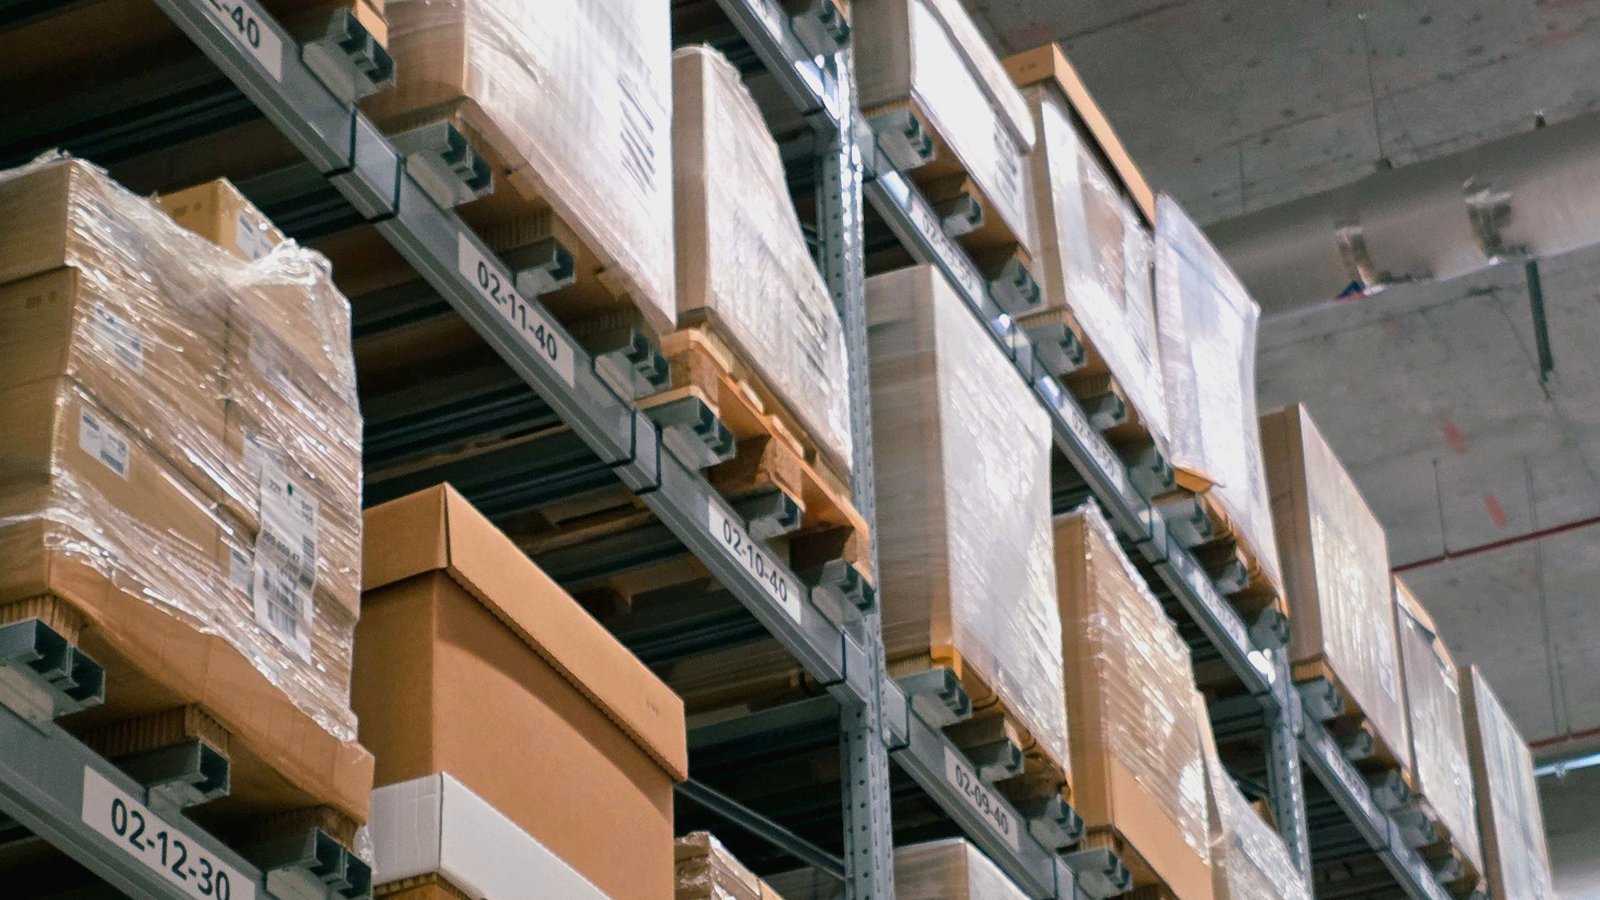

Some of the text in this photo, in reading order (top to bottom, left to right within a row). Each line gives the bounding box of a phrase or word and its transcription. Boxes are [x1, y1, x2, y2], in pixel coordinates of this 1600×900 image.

[208, 0, 260, 48] -40
[477, 260, 557, 361] 02-11-40
[723, 518, 787, 603] 02-10-40
[955, 764, 1009, 835] 02-09-40
[111, 798, 230, 900] 02-12-30
